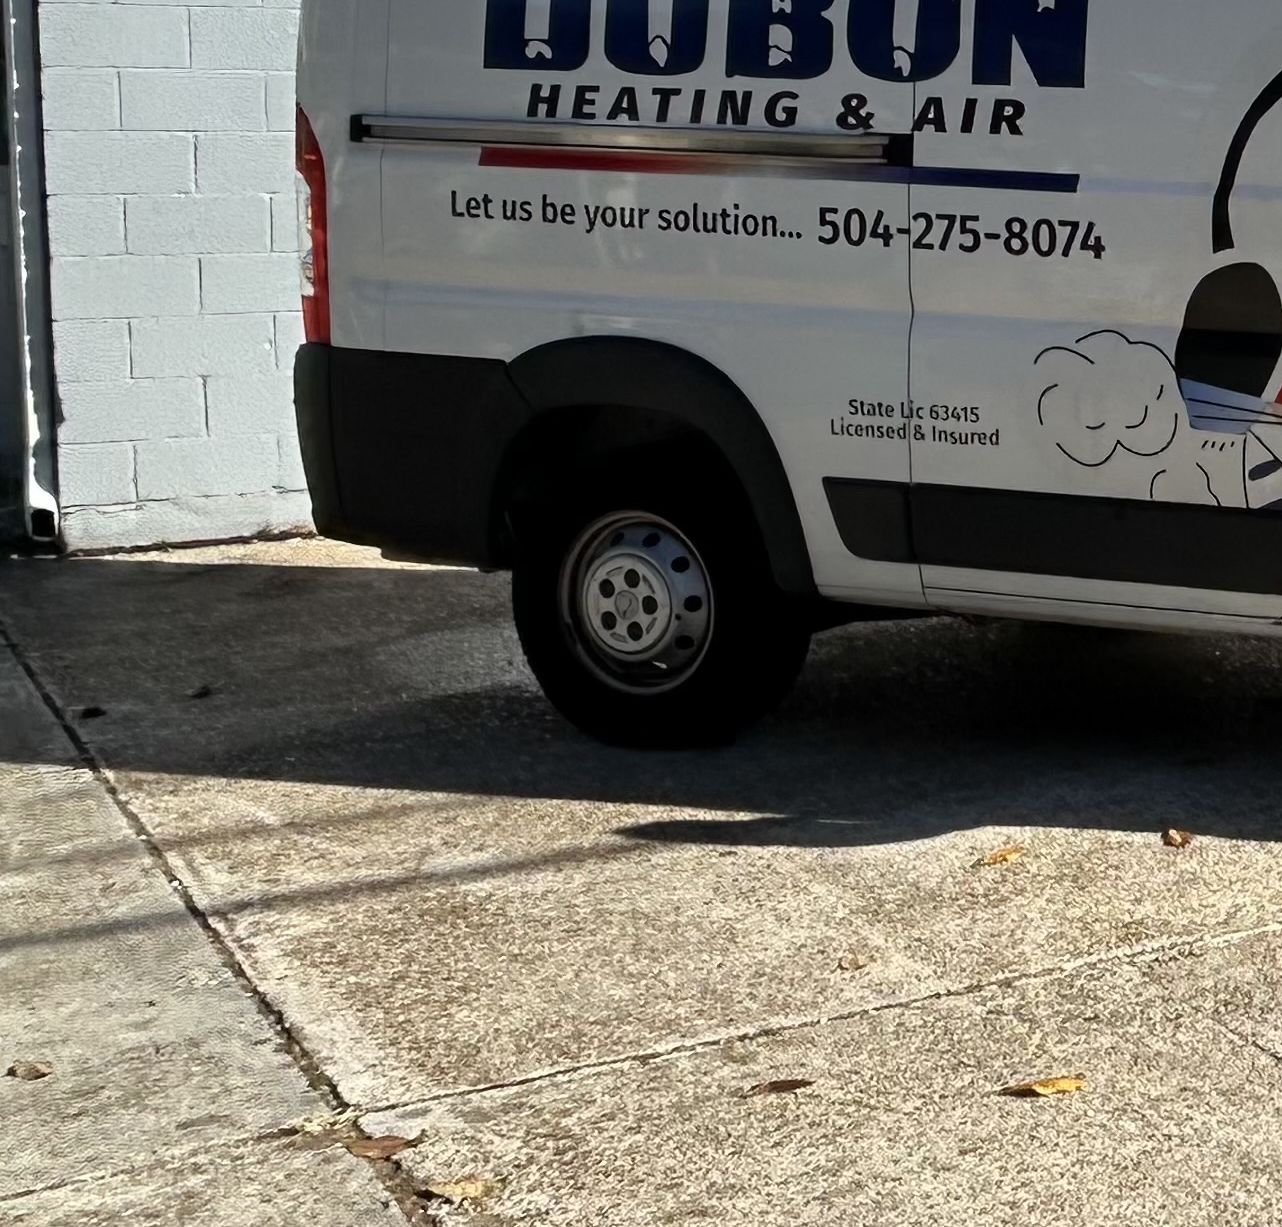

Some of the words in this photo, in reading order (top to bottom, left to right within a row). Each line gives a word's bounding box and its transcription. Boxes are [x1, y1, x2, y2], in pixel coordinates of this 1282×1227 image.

[527, 83, 799, 129] HEATING
[836, 92, 875, 133] &
[912, 96, 1027, 138] AIR
[450, 190, 494, 220] Let
[501, 198, 533, 223] us
[541, 194, 576, 225] be
[585, 203, 650, 234] your
[657, 202, 803, 240] solution...
[816, 206, 1107, 260] 504-275-8074
[830, 417, 908, 441] Licensed
[913, 424, 926, 441] &
[932, 426, 1000, 446] Insured
[848, 399, 895, 418] State
[900, 399, 925, 420] Lic
[929, 404, 981, 424] 63415
